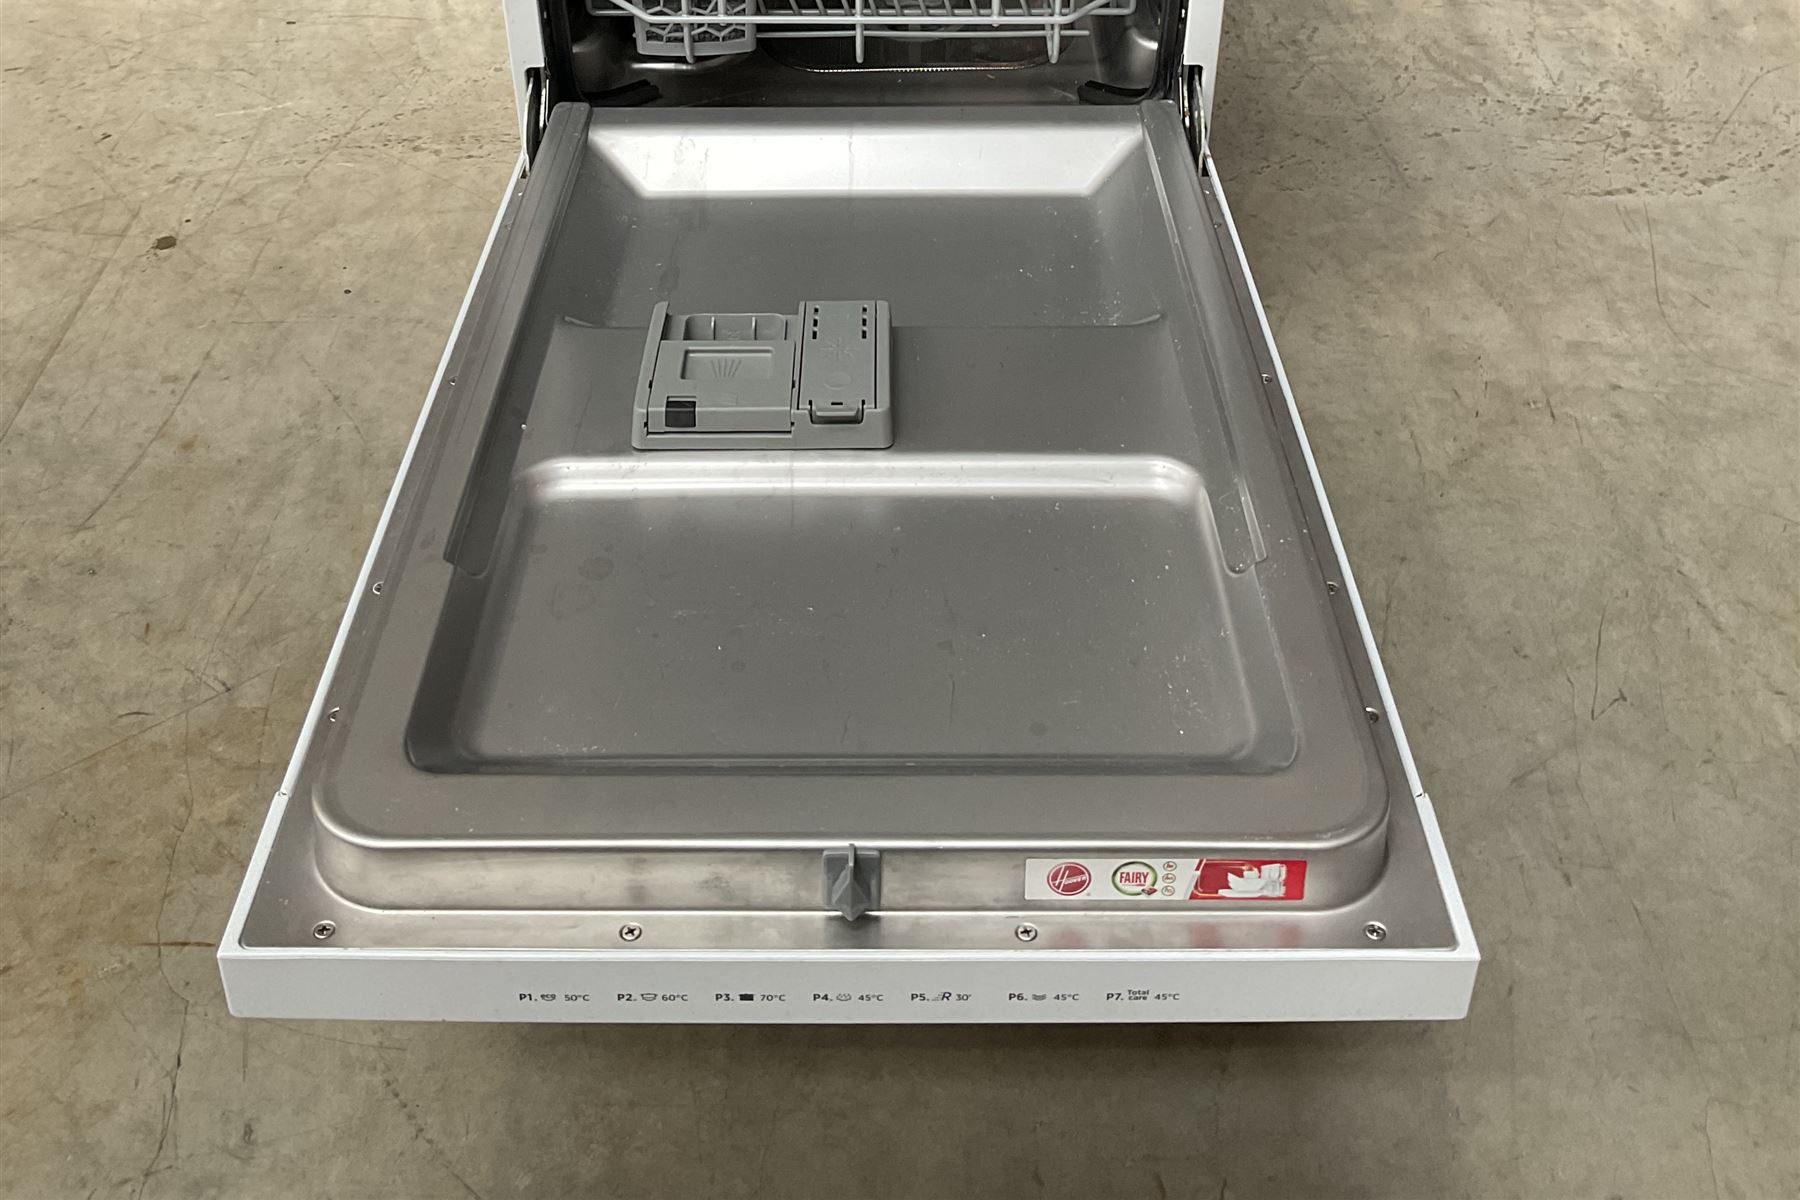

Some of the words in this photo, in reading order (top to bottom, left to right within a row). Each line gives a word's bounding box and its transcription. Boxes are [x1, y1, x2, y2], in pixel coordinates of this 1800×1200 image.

[1119, 871, 1149, 884] FAIRY
[518, 993, 538, 1002] P1.
[564, 993, 590, 1002] 50°C
[617, 993, 637, 1002] P2.
[661, 993, 688, 1002] 60°C
[715, 993, 735, 1002] P3.
[760, 993, 787, 1002] 70°C
[813, 993, 833, 1002] P4.
[857, 993, 884, 1002] 45°C
[910, 992, 930, 1002] P5.
[1008, 992, 1028, 1001] P6.
[1053, 993, 1079, 1001] 45°C
[1106, 992, 1124, 1001] P7.
[1154, 993, 1180, 1001] 45°C
